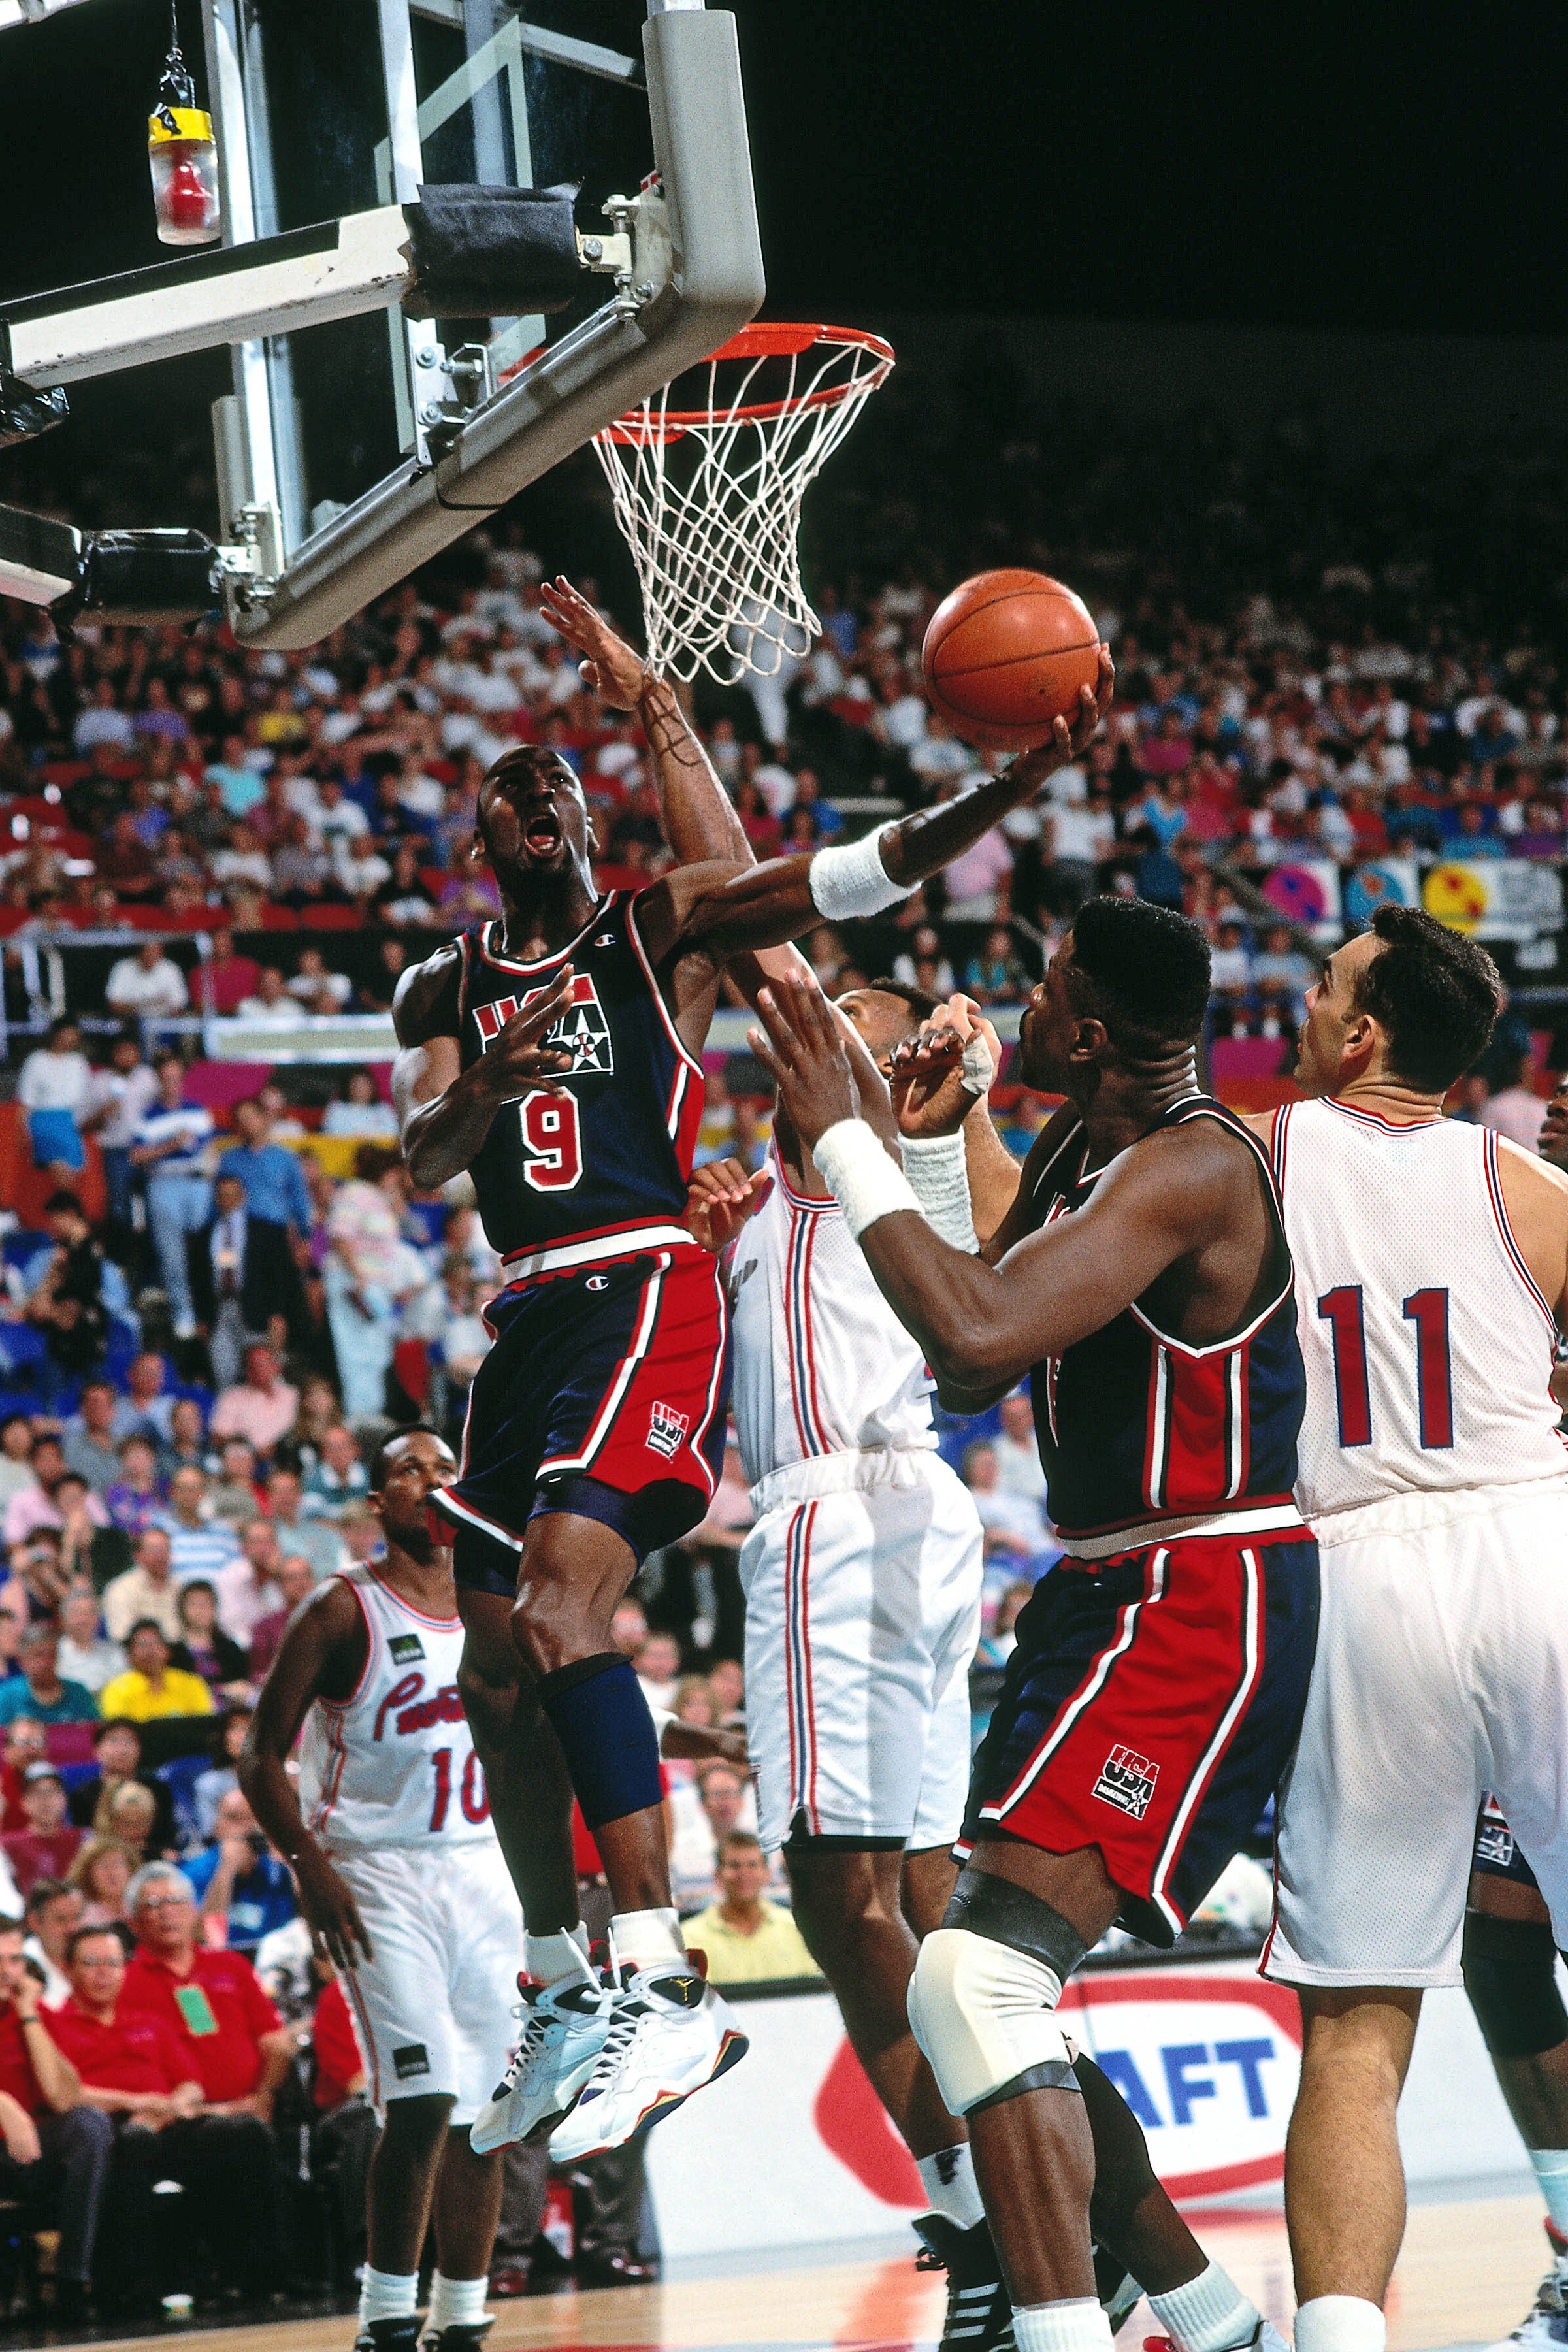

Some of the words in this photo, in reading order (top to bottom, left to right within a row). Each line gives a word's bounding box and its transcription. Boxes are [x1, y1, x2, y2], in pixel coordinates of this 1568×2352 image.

[519, 1086, 583, 1192] 9
[1317, 1284, 1454, 1449] 11
[429, 1747, 491, 1831] 10
[1102, 1744, 1160, 1806] USA
[1095, 2038, 1275, 2128] AFT
